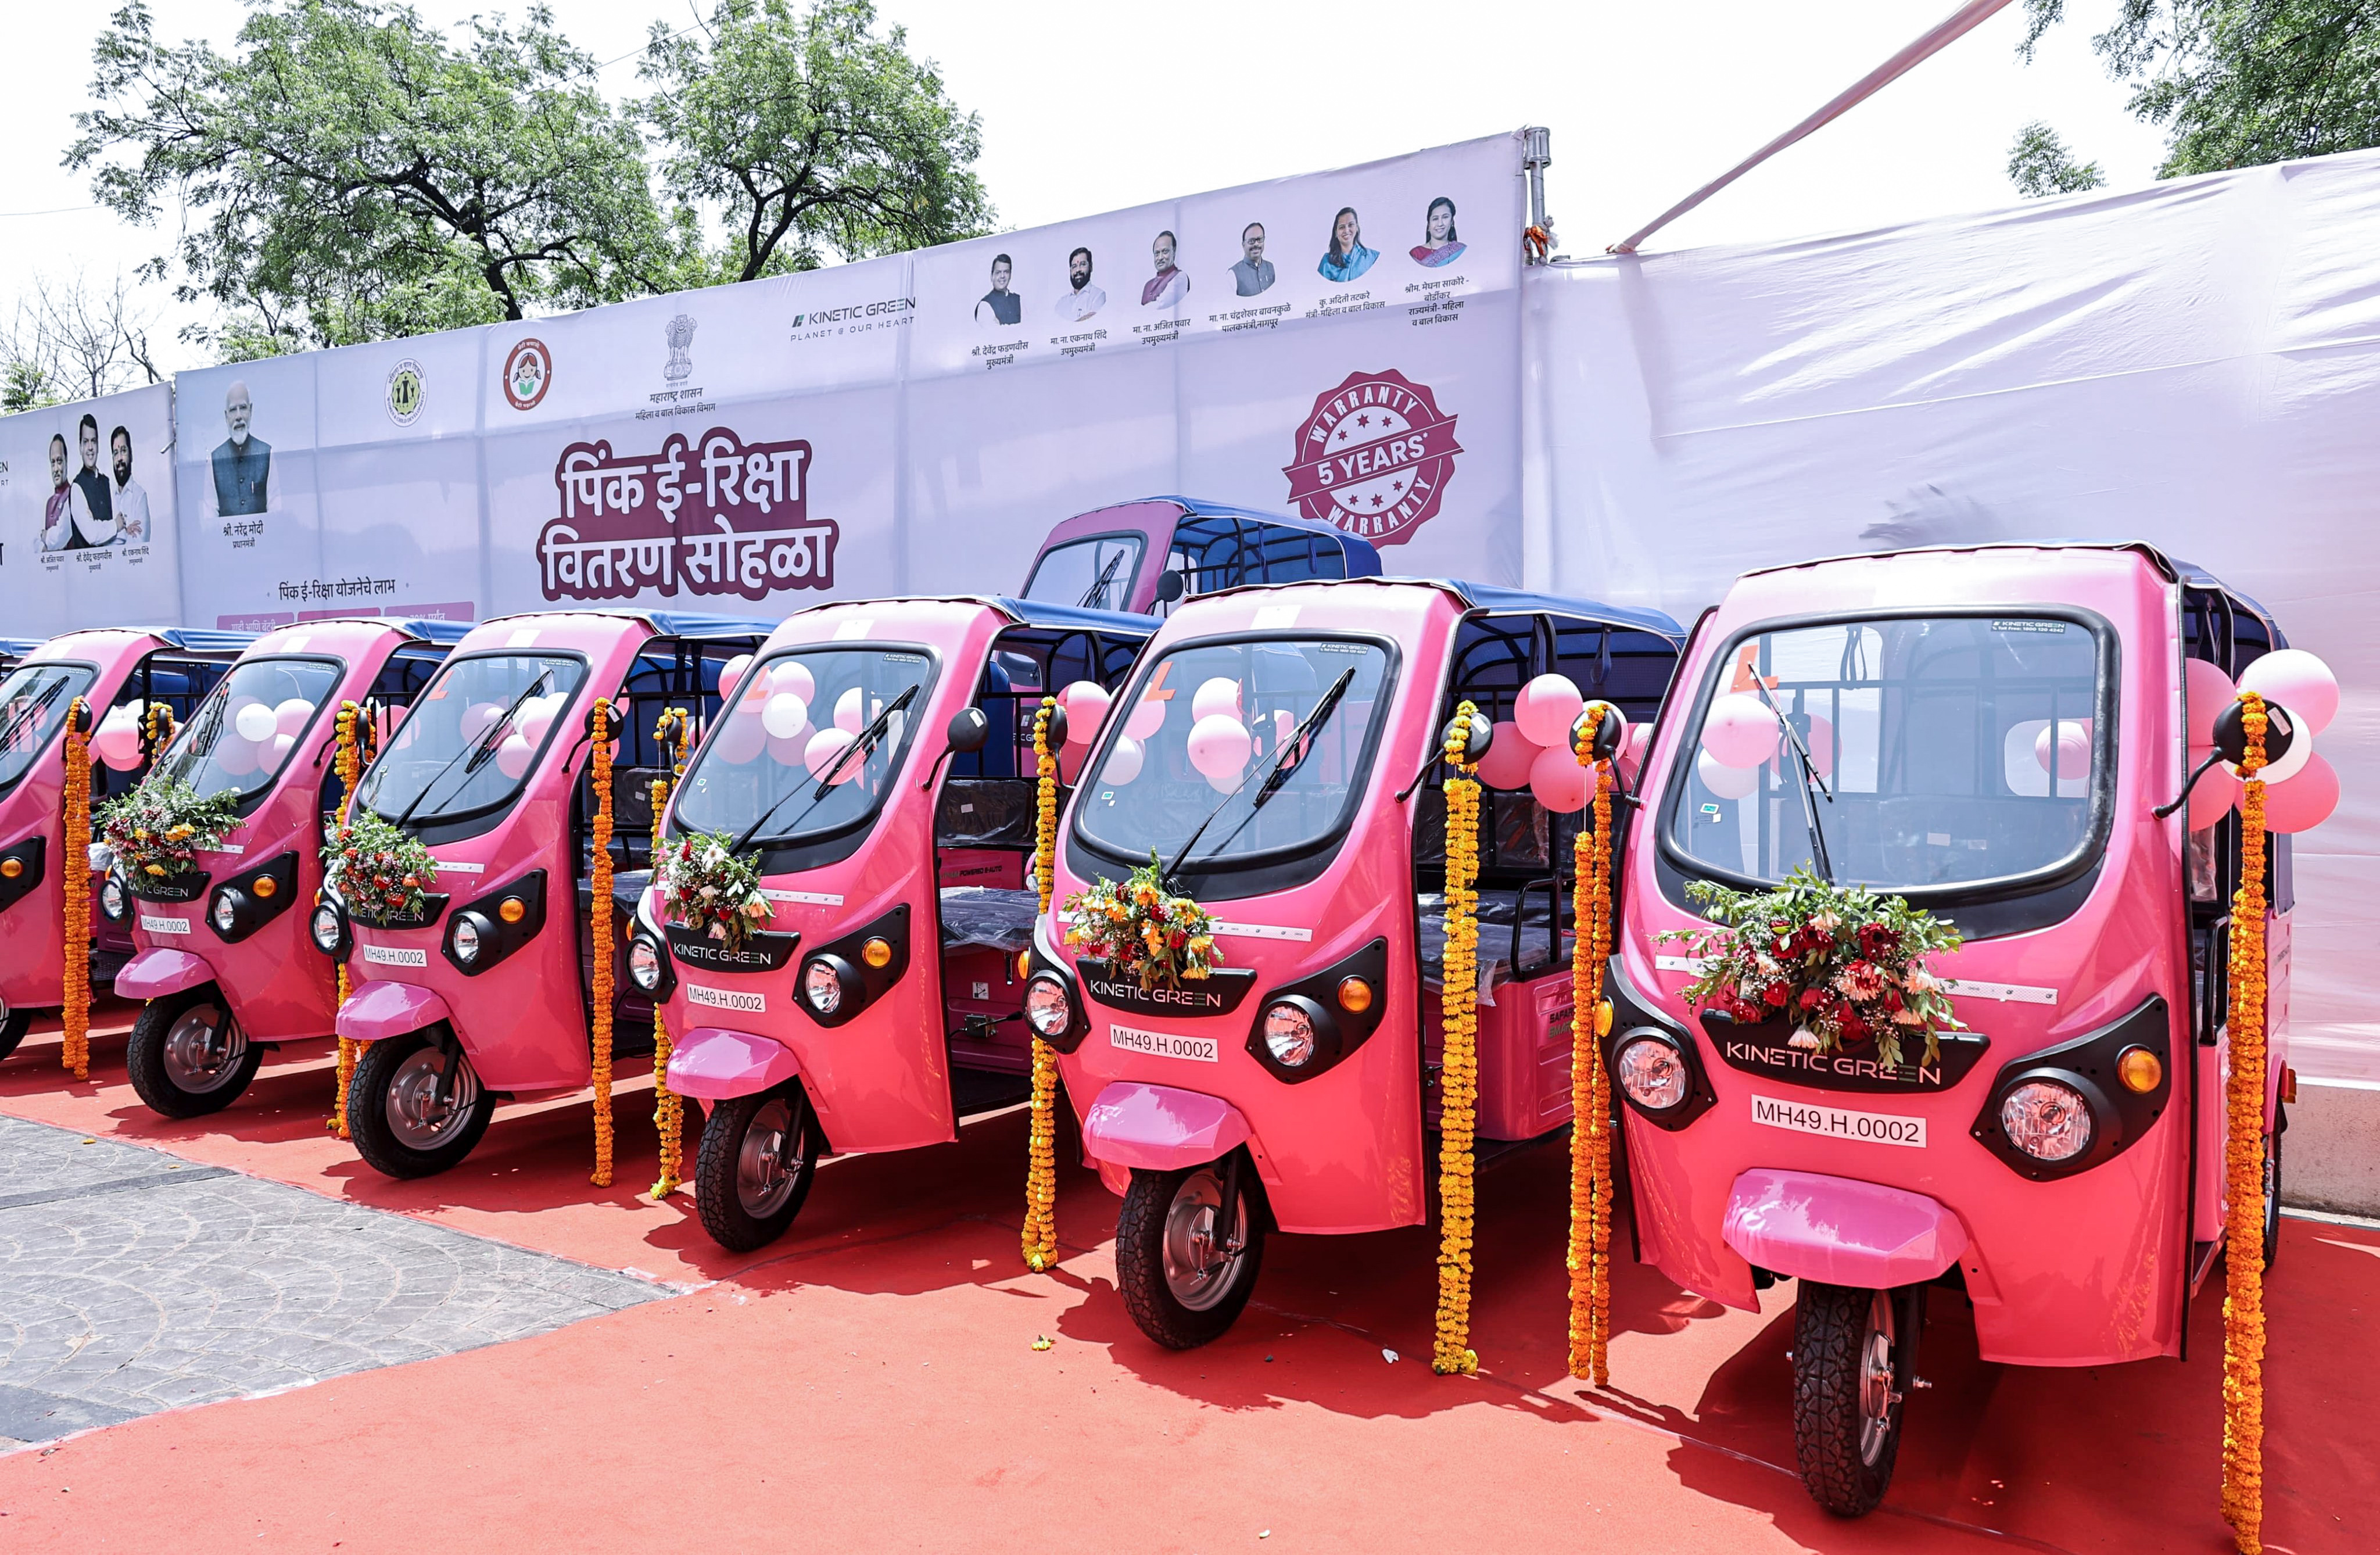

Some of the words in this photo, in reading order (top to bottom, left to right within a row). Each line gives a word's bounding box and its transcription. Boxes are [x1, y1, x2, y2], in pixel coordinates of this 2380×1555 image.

[1422, 280, 1440, 291] मेघना
[1442, 276, 1465, 288] साकोरे
[1329, 294, 1349, 304] अदिती
[1350, 290, 1371, 302] तटकरे
[1442, 300, 1465, 311] महिला
[809, 305, 863, 325] KINETIC
[866, 296, 916, 316] GREEN
[1209, 314, 1218, 323] मा.
[1220, 313, 1229, 321] ना.
[1230, 307, 1258, 320] चंद्रशेखर
[1259, 302, 1292, 317] बावनकुळे
[1348, 304, 1362, 313] बाल
[1363, 300, 1386, 311] विकास
[1132, 325, 1142, 334] मा.
[1143, 324, 1152, 333] ना.
[1153, 320, 1173, 331] अजित
[1174, 318, 1192, 328] पवार
[1419, 317, 1433, 326] बाल
[1435, 313, 1458, 324] विकास
[790, 329, 833, 342] PLANET
[850, 323, 872, 334] OUR
[878, 316, 915, 329] HEART
[1060, 336, 1069, 344] ना.
[1070, 332, 1094, 343] एकनाथ
[1094, 328, 1107, 341] शिंदे
[972, 345, 981, 357] श्री.
[982, 343, 997, 356] देवेंद्र
[997, 339, 1029, 353] फडणवीस
[985, 354, 1014, 370] मुख्यमंत्री
[649, 390, 679, 404] महाराष्ट्र
[680, 387, 703, 399] शासन
[635, 409, 654, 421] महिला
[661, 408, 673, 418] बाल
[675, 404, 696, 416] विकास
[697, 402, 716, 413] विभाग
[1310, 386, 1418, 443] WARRANTY
[560, 448, 647, 518] पिंक
[653, 436, 805, 524] ई-रिक्षा
[1317, 461, 1334, 485] 5
[1327, 476, 1432, 534] WARRANTY
[223, 522, 234, 536] श्री.
[234, 522, 248, 537] नरेंद्र
[248, 519, 264, 535] मोदी
[232, 537, 255, 549] प्रधानमंत्री
[541, 524, 676, 590] वितरण
[682, 513, 832, 589] सोहळा
[278, 580, 299, 601] पिंक
[300, 581, 334, 603] ई-रिक्षा
[335, 576, 372, 597] योजनेचे
[374, 578, 396, 595] लाभ
[153, 886, 188, 897] GREEN
[142, 918, 188, 931] MH49.H.0002
[386, 910, 424, 922] REEN
[365, 947, 424, 964] MH49.H.0002
[673, 942, 717, 960] KINETIC
[719, 950, 772, 965] GREEN
[689, 987, 762, 1011] MH49.H.0002
[1090, 979, 1150, 1001] KINETIC
[1152, 988, 1221, 1008] GREEN
[1550, 1007, 1573, 1024] SAFAR
[1549, 1020, 1572, 1038] SMAR
[1113, 1029, 1214, 1059] MH49.H.0002
[1726, 1041, 1828, 1072] KINETIC
[1833, 1058, 1941, 1085] GREEN
[1757, 1100, 1920, 1143] MH49.H.0002
